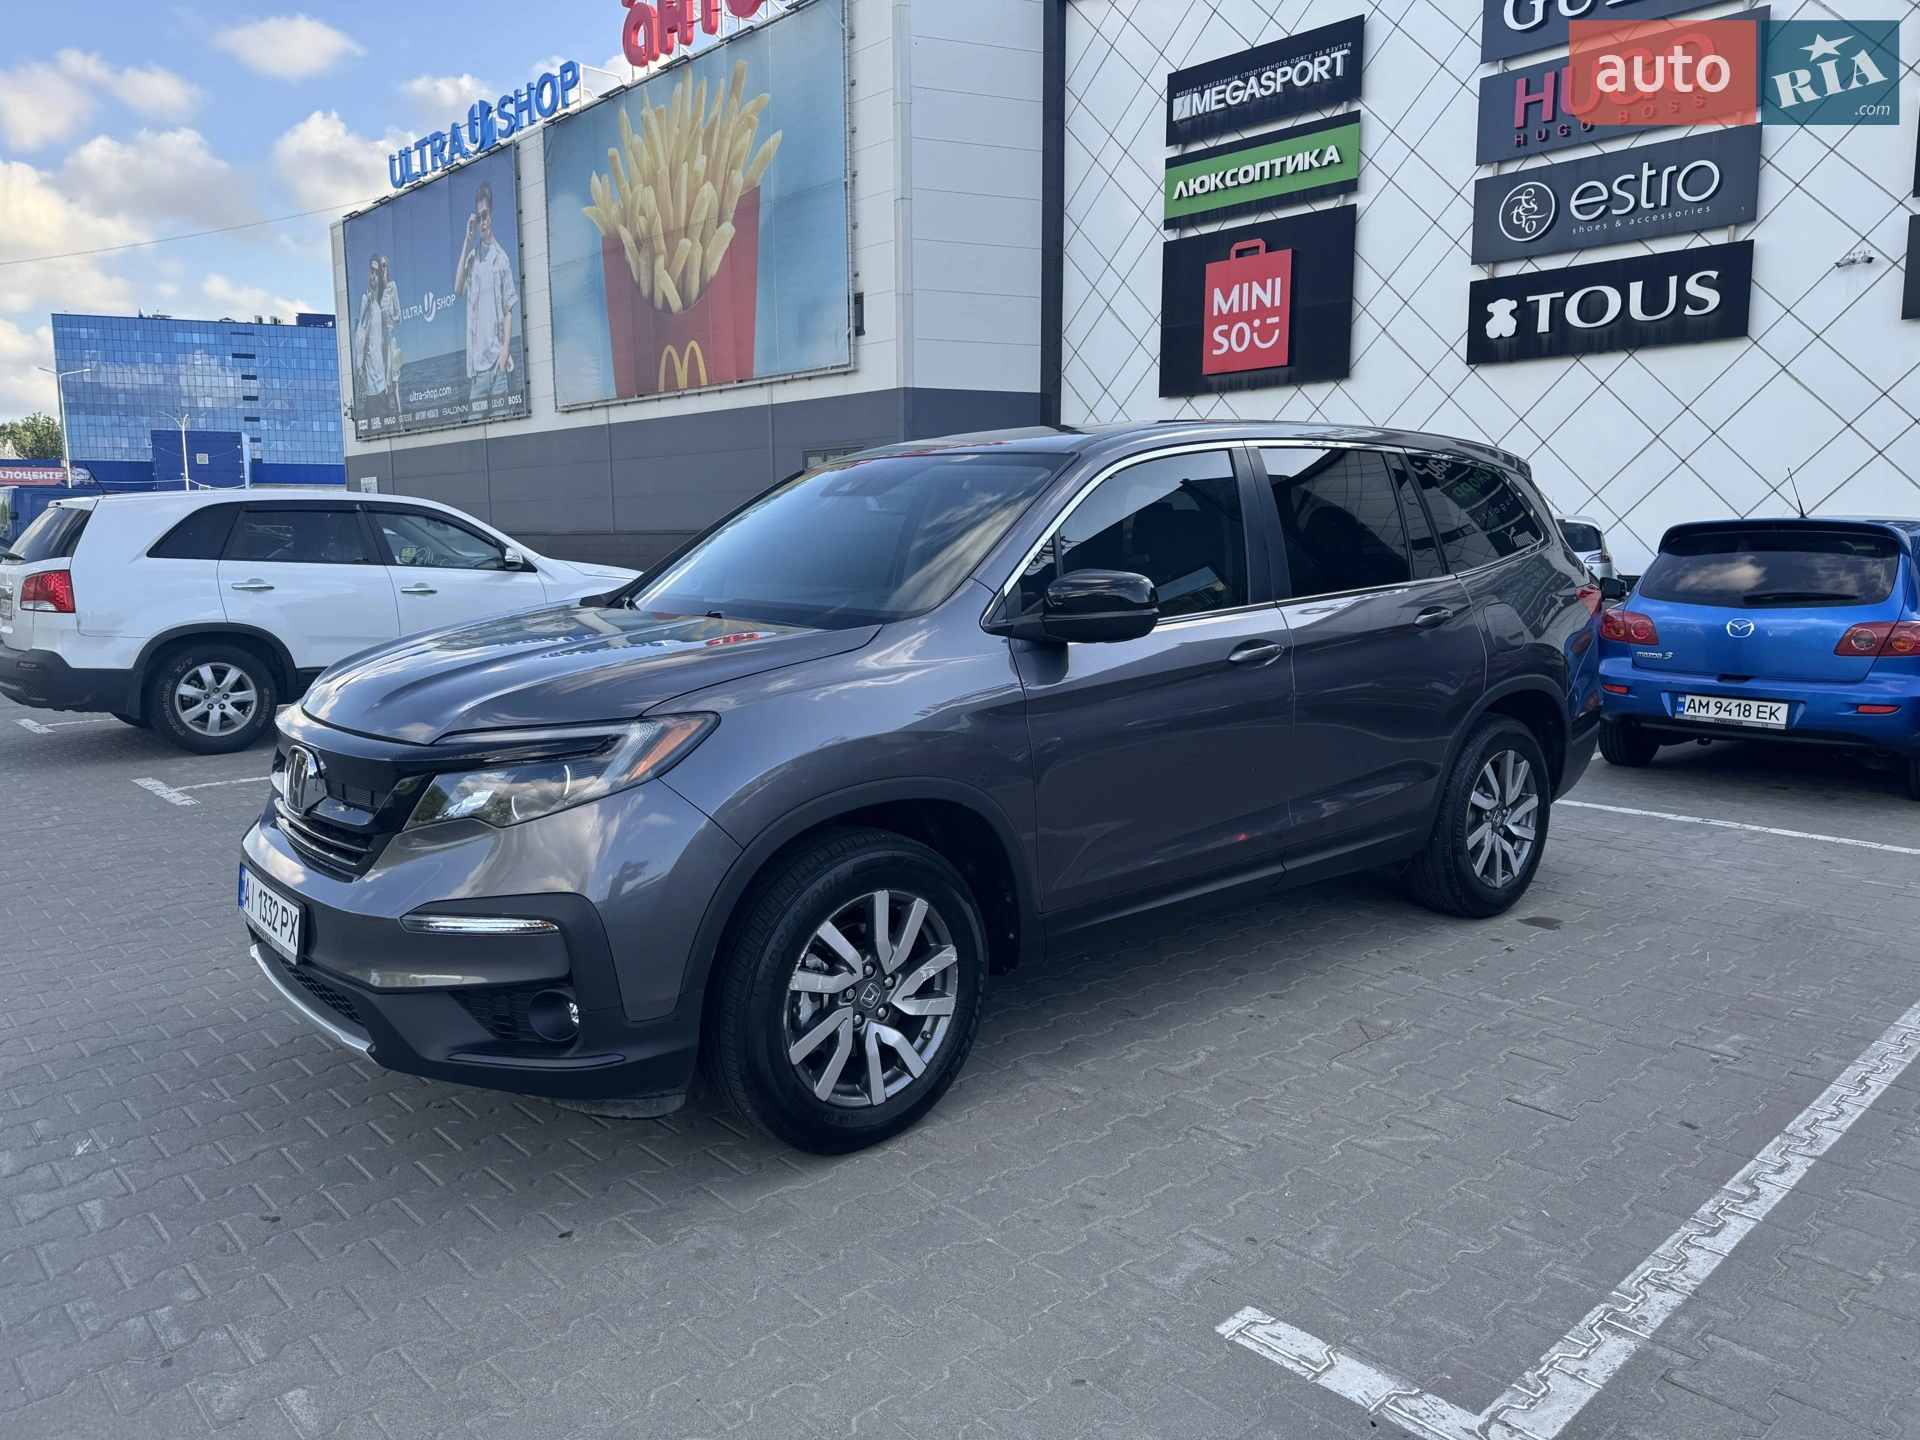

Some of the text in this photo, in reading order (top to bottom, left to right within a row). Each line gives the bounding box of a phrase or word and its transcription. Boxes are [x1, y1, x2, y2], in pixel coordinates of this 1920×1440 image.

[1176, 41, 1352, 98] мережа магазинів спортивного одягу та взуття
[1191, 49, 1351, 116] MEGASPORT
[1514, 32, 1717, 128] HUGO
[389, 60, 580, 189] ULTRA SHOP
[1514, 95, 1707, 146] HUGO BOSS
[1173, 144, 1342, 200] ЛЮКСОПТИКА
[1569, 159, 1720, 221] estro
[1572, 207, 1711, 235] shoes & accessories
[402, 294, 456, 320] ULTRA SHOP
[1213, 277, 1281, 317] MINI
[1527, 270, 1721, 334] TOUS
[409, 386, 452, 402] ultra-shop.com
[508, 394, 522, 405] BOSS
[1686, 698, 1781, 721] AM 9418 EK
[245, 877, 255, 912] AI
[258, 889, 278, 933] 1332
[280, 905, 298, 947] PX
